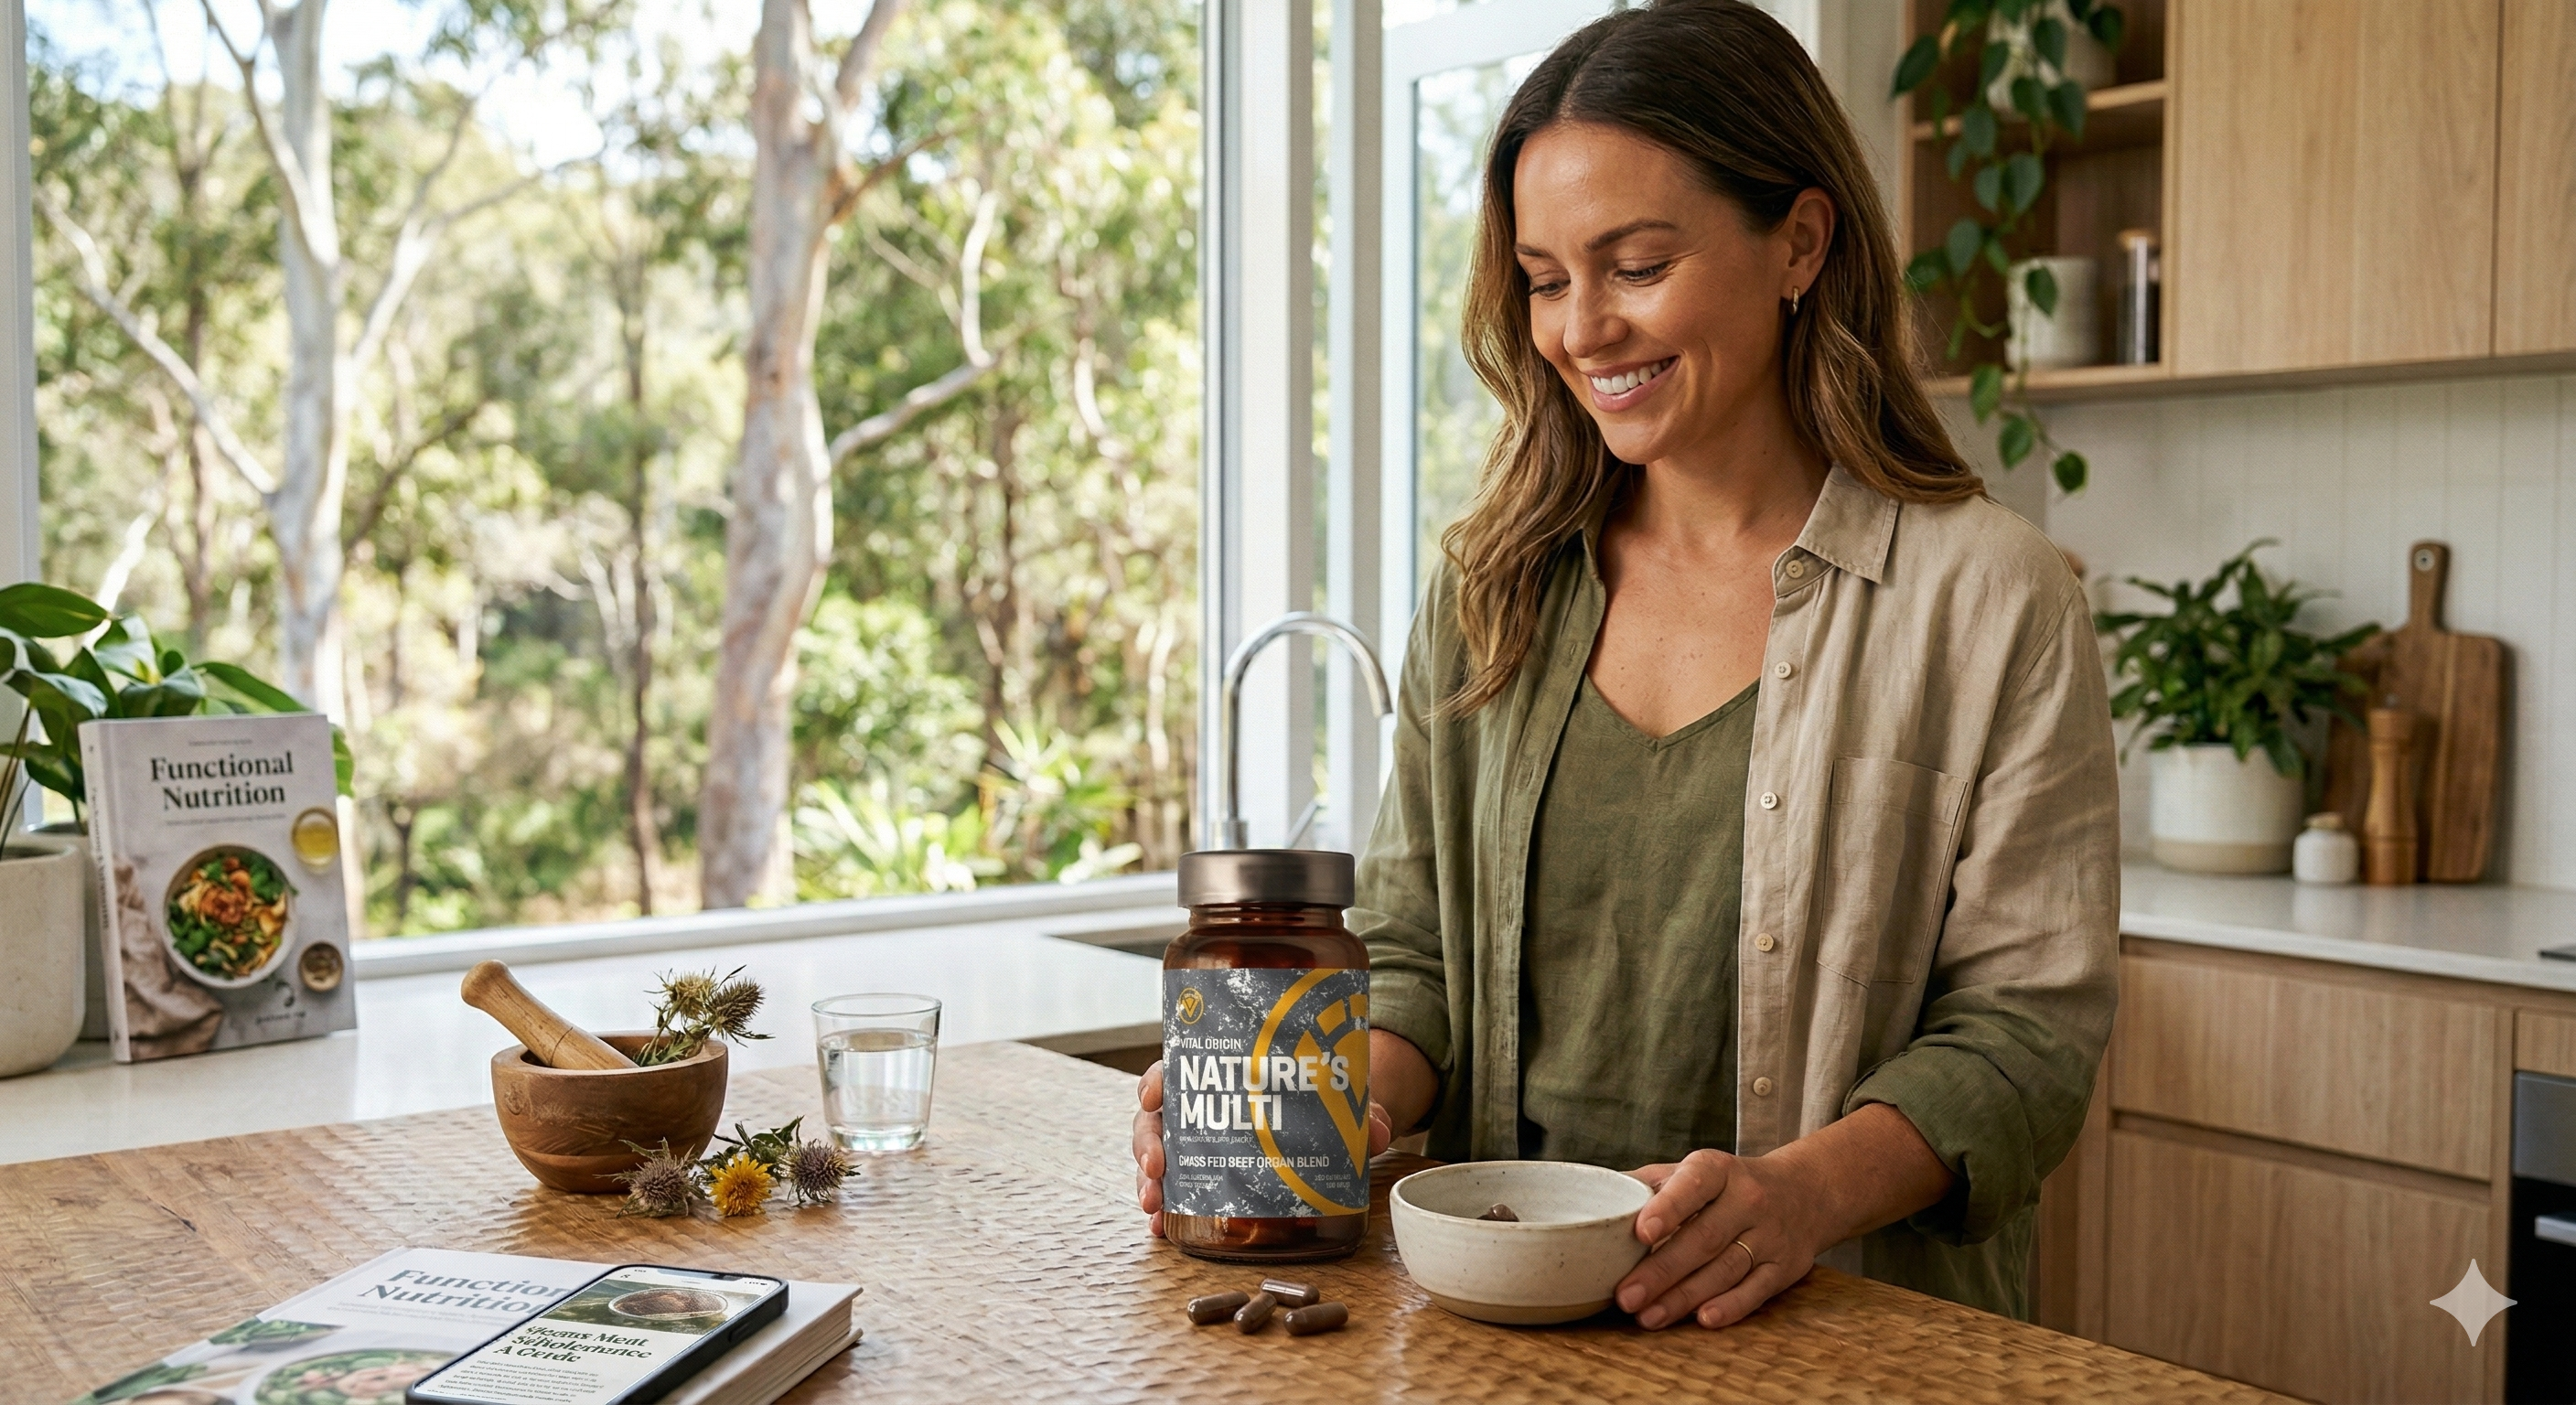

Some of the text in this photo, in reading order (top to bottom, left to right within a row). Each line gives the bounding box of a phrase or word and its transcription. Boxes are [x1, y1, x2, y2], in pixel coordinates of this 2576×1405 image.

[151, 750, 294, 782] Functional
[163, 781, 285, 810] Nutrition
[1180, 1037, 1204, 1049] VITAL
[1179, 1052, 1350, 1092] NATURE'S
[1179, 1094, 1283, 1132] MULTI
[1208, 1156, 1227, 1168] FED
[1256, 1156, 1294, 1169] ORGAN
[1296, 1155, 1330, 1169] BLEND
